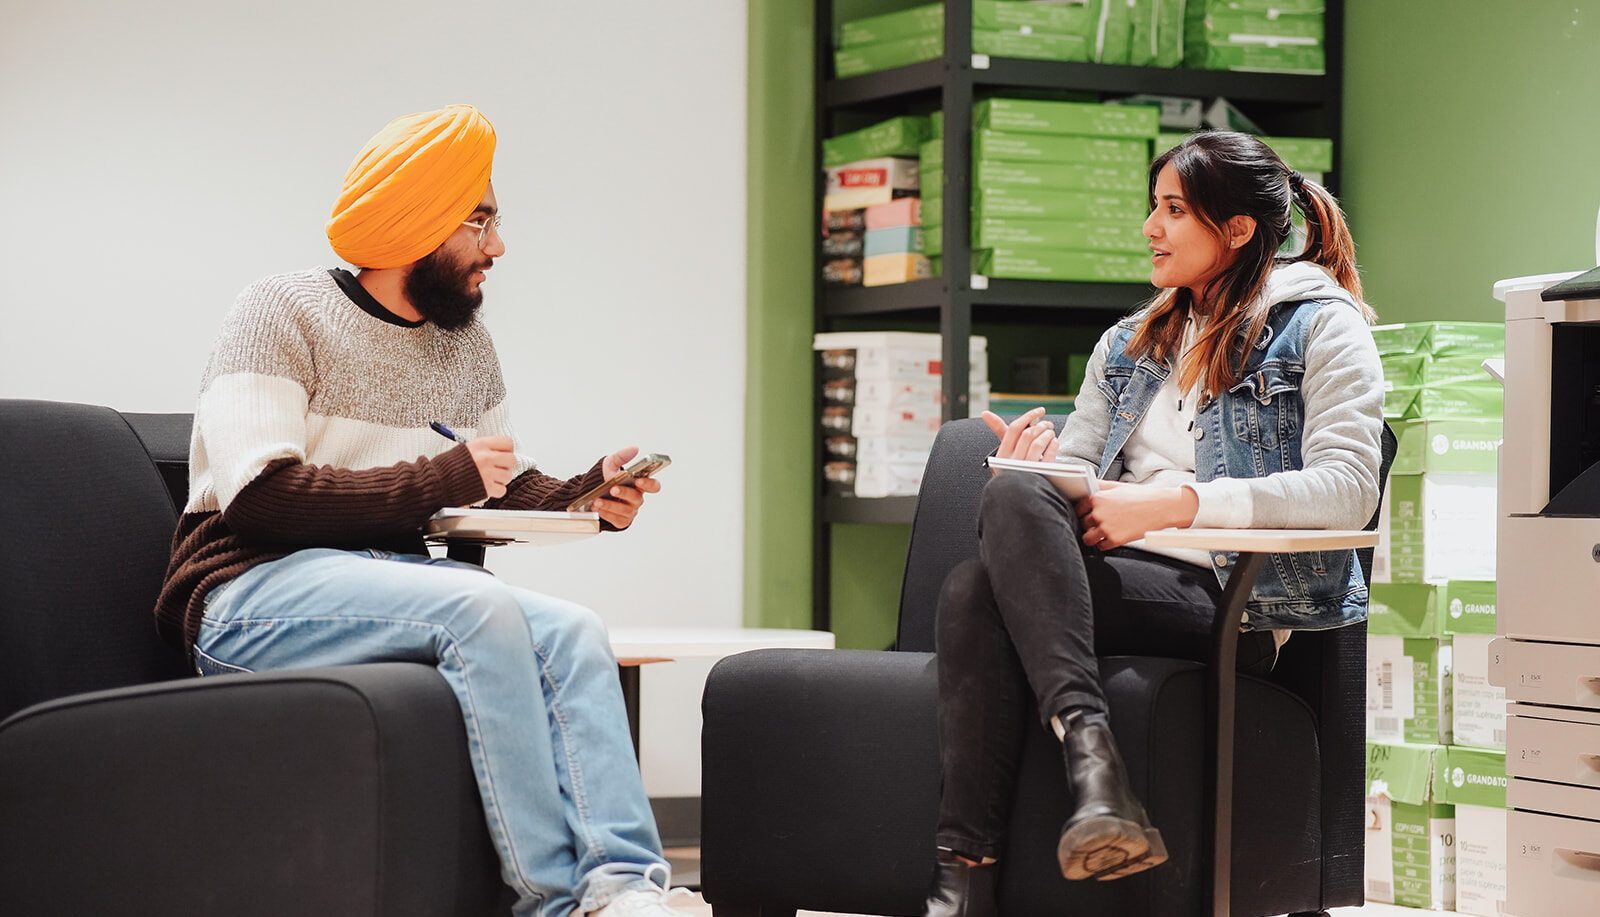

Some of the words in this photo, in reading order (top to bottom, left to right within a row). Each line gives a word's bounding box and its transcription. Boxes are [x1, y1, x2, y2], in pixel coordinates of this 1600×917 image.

[1495, 655, 1500, 664] 5
[1467, 773, 1507, 787] GRAND&TO
[1440, 833, 1453, 847] 10
